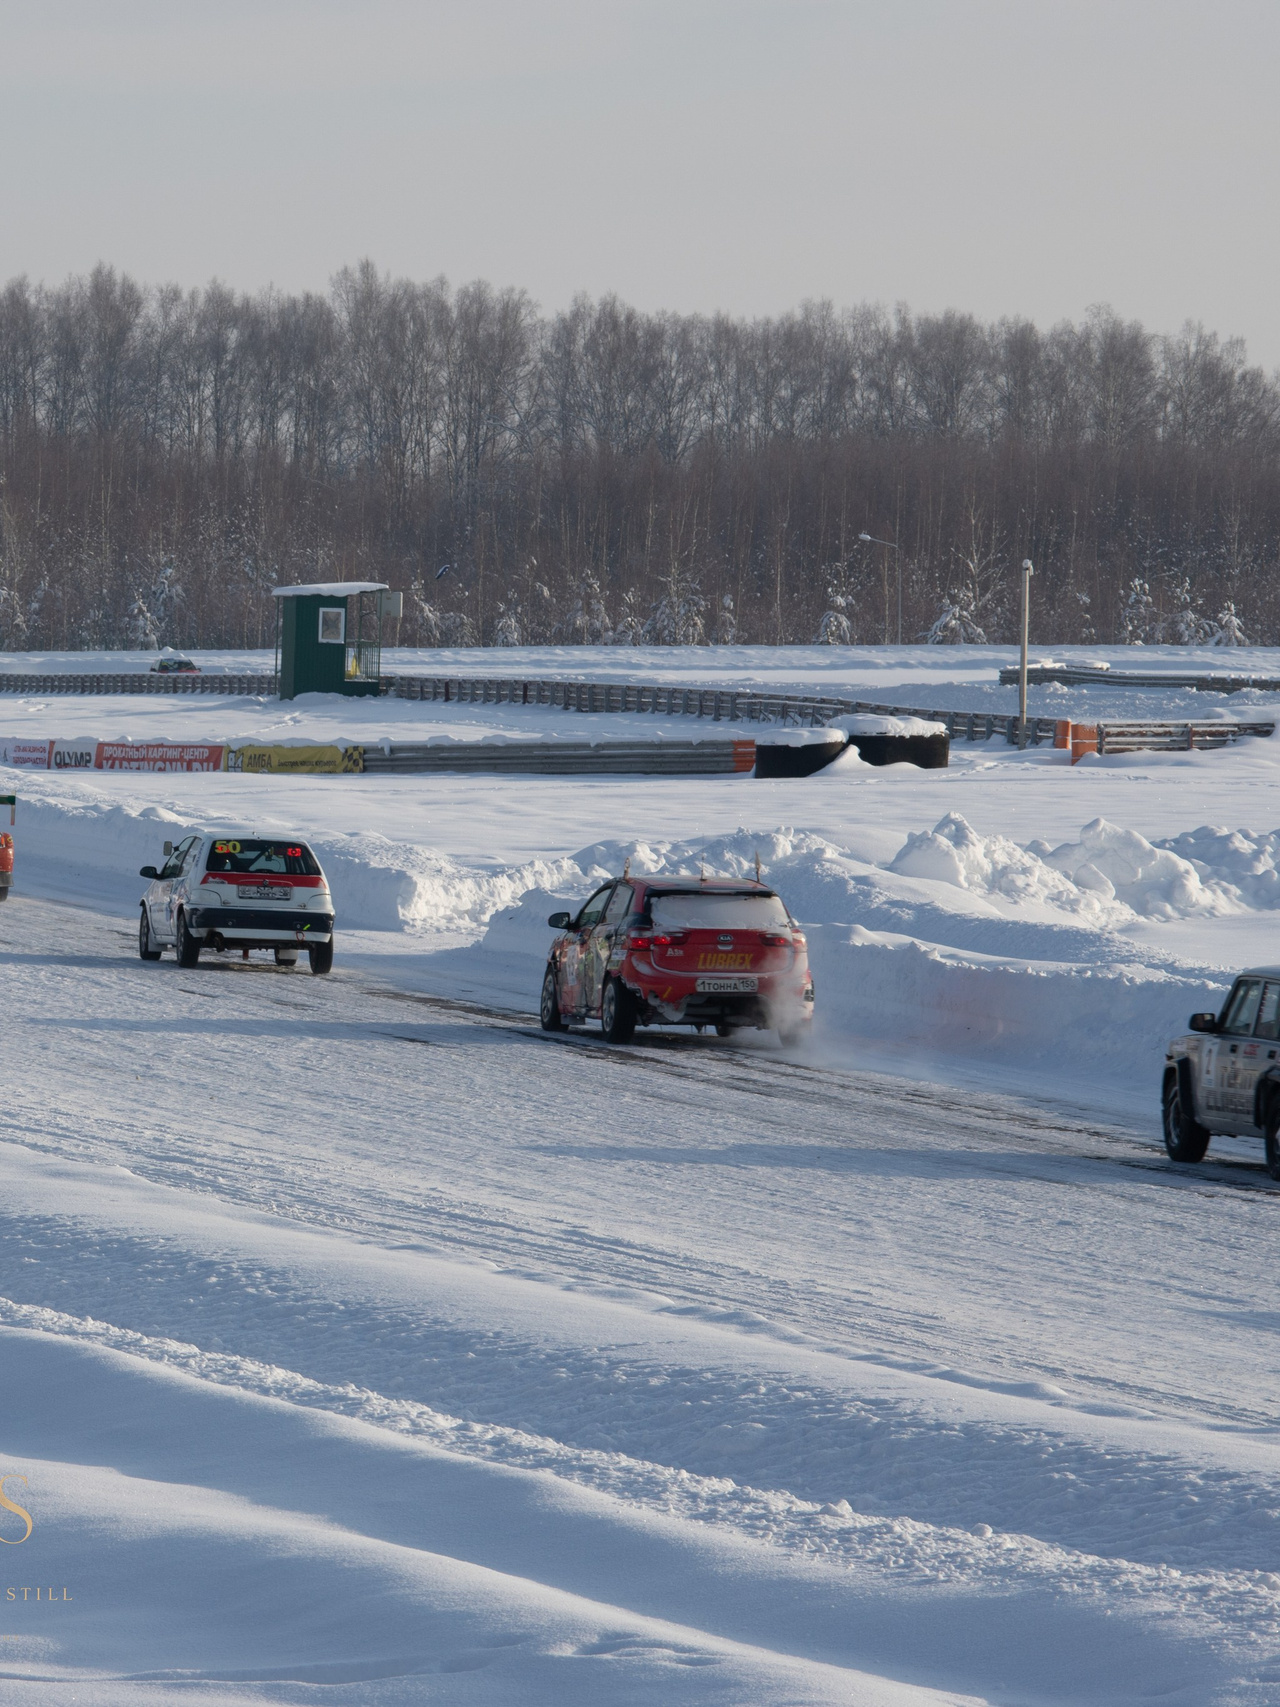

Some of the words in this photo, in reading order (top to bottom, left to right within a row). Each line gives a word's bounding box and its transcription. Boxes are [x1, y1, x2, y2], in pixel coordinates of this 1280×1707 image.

[54, 750, 92, 767] OLYMP
[103, 746, 147, 759] ПРОКАТНЫЙ
[148, 747, 209, 760] КАРТИНГ-ЦЕНТР
[102, 760, 215, 772] KARTINGNNRU
[247, 753, 272, 768] АМБА
[215, 841, 240, 853] 50
[698, 953, 753, 970] LUBREX
[741, 981, 755, 989] 150
